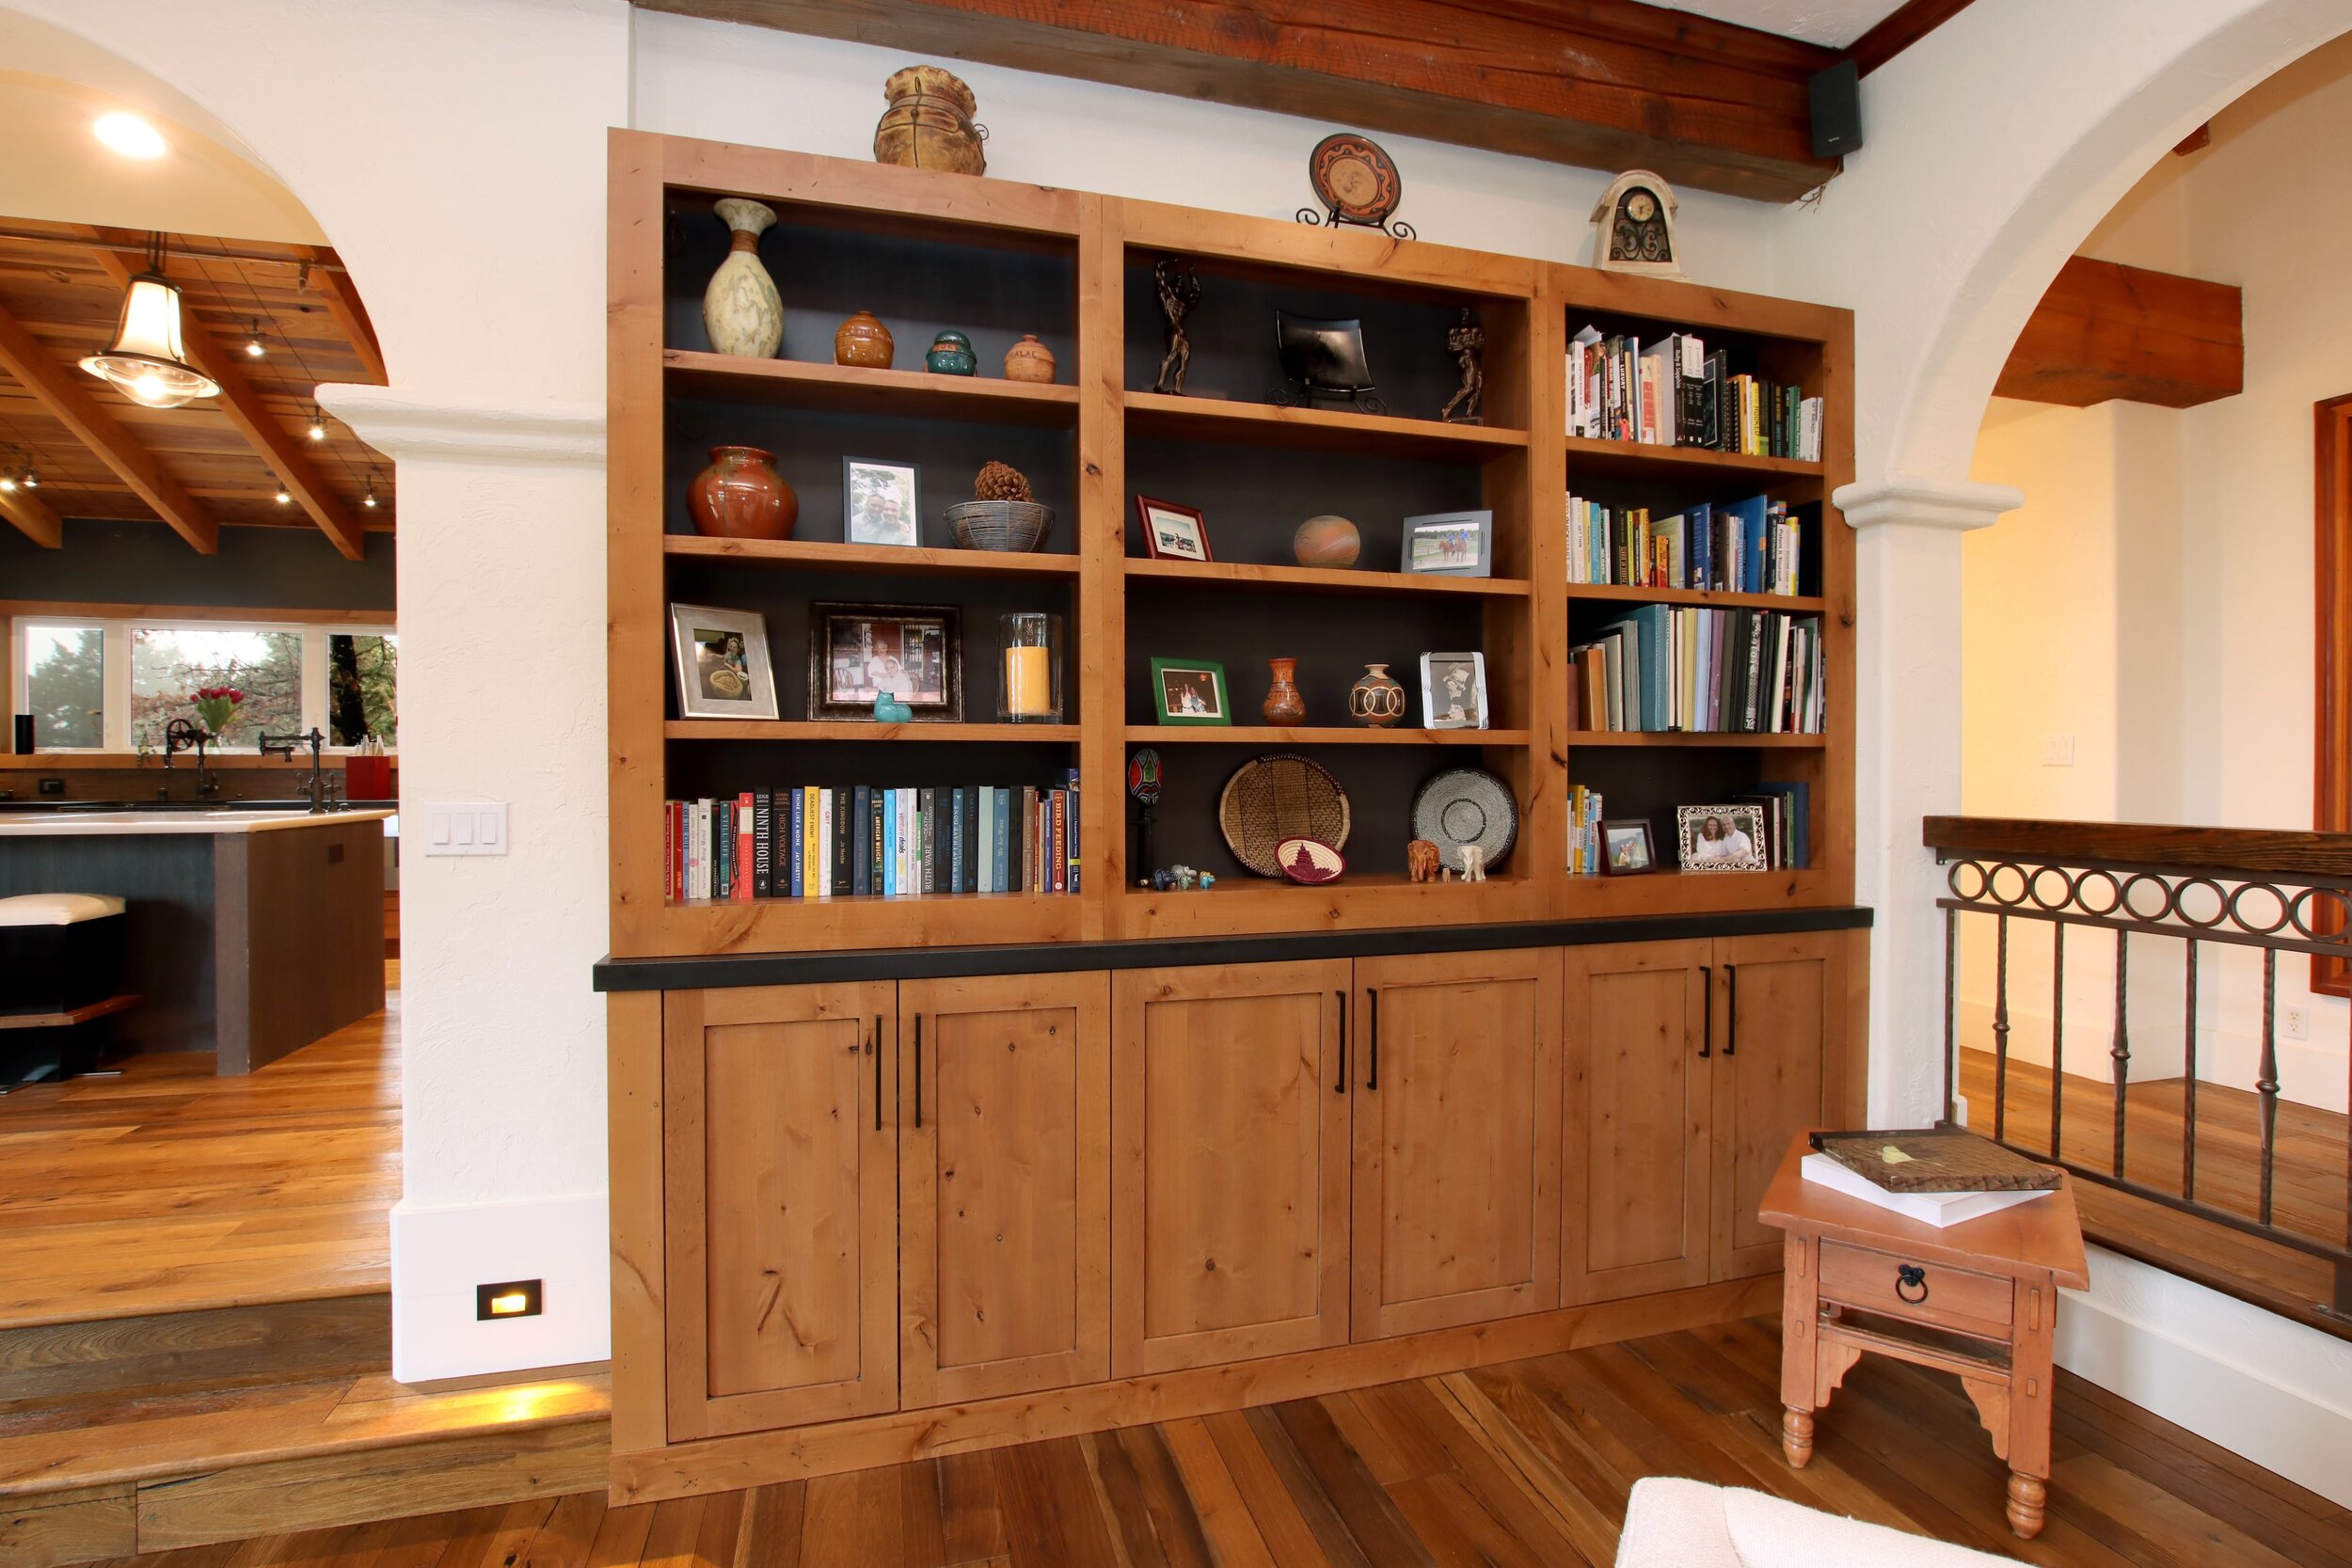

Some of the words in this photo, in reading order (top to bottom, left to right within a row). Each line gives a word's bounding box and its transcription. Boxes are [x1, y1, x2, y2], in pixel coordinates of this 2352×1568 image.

[756, 808, 769, 839] NINTH
[756, 842, 769, 874] HOUSE
[998, 847, 1003, 857] We
